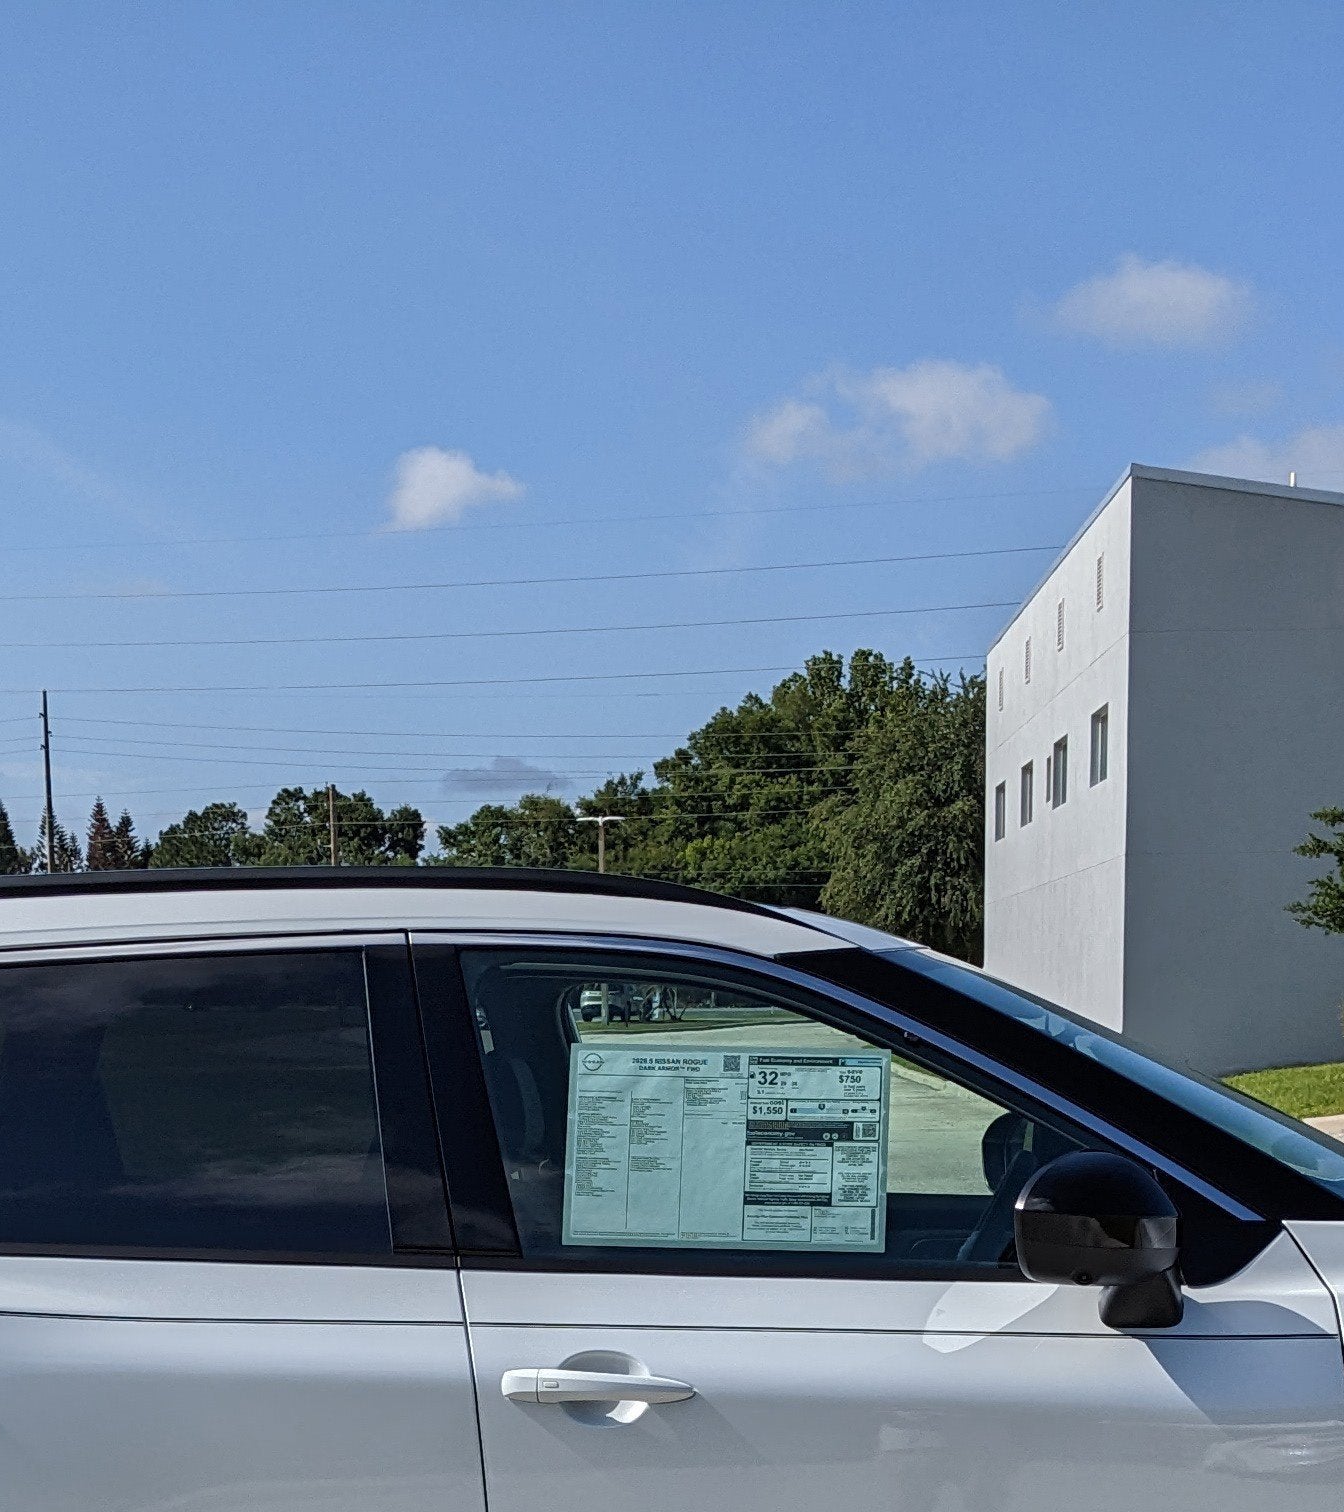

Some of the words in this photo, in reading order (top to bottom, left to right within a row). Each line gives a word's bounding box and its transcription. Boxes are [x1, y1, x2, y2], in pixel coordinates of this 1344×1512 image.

[683, 1058, 709, 1066] ROGUE
[758, 1070, 779, 1086] 32
[839, 1074, 862, 1084] $750
[752, 1106, 784, 1115] $1,550
